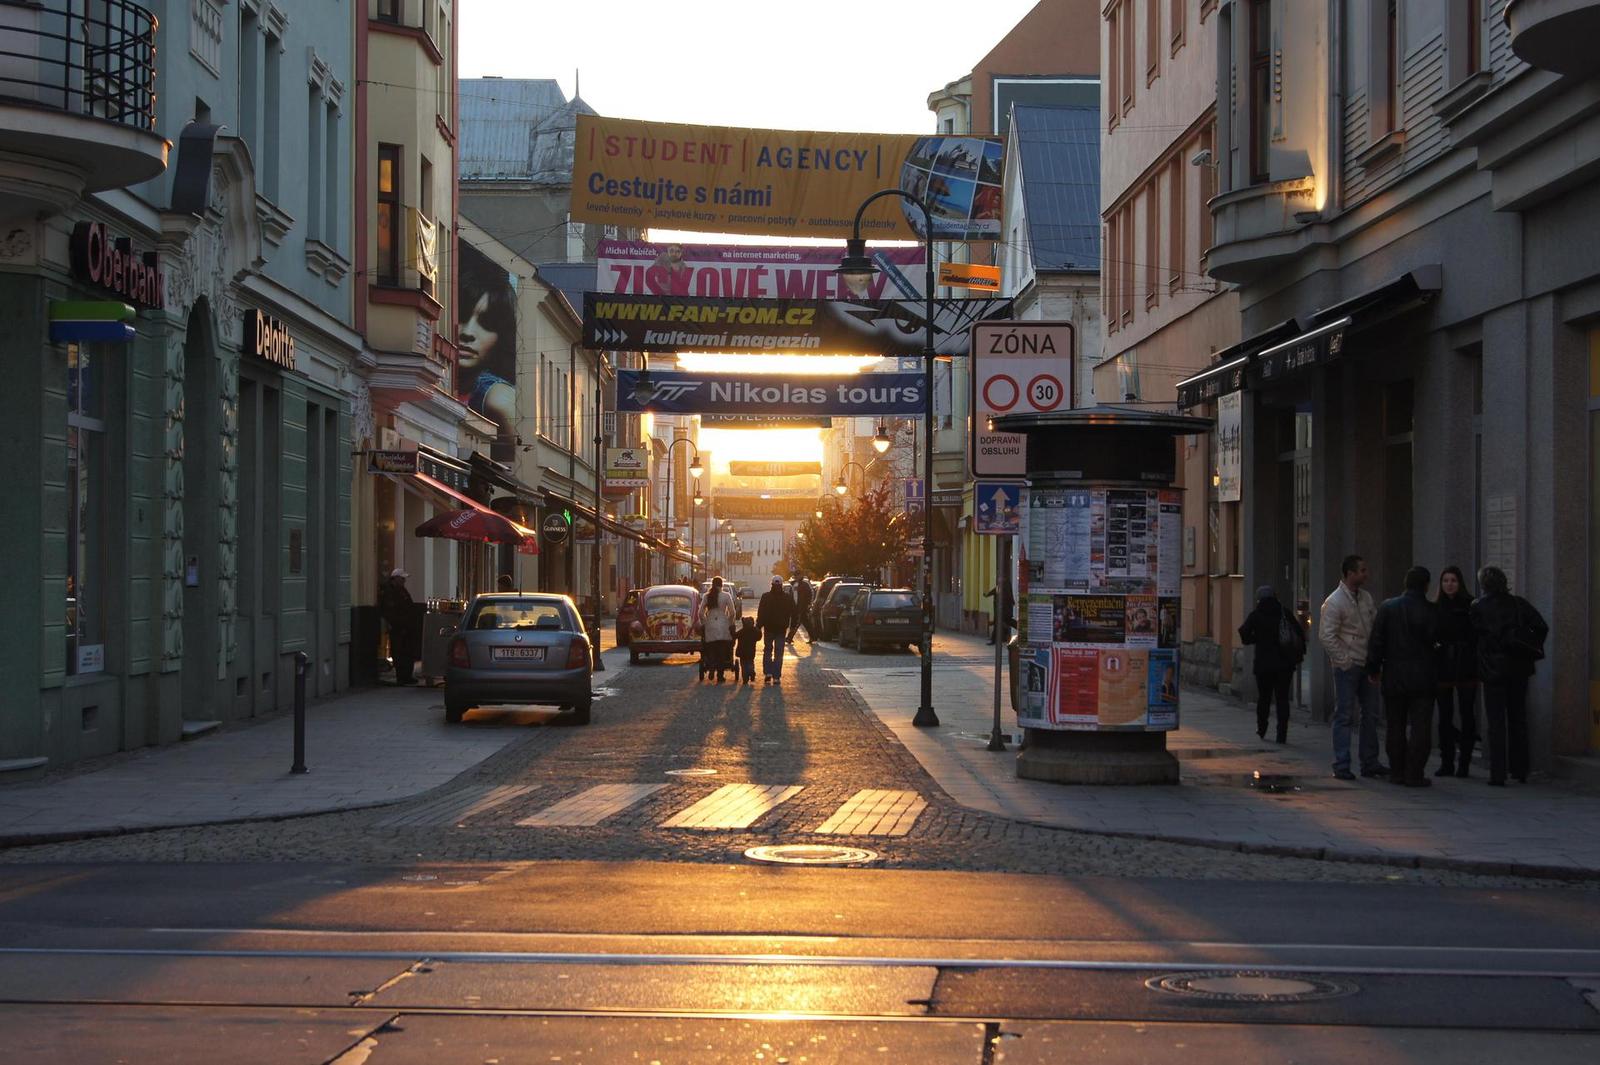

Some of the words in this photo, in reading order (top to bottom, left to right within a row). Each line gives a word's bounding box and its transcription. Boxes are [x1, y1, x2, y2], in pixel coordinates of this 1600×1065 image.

[605, 135, 732, 164] STUDENT
[756, 146, 868, 171] AGENCY
[588, 172, 688, 205] Cestujte
[695, 187, 707, 203] s
[714, 182, 772, 206] námi
[728, 214, 764, 224] pracovní
[767, 215, 797, 227] pobyty
[605, 246, 628, 256] Michal
[733, 250, 762, 259] internet
[88, 222, 165, 310] Oberbank
[595, 302, 816, 325] WWW.FAN-TOM.CZ
[644, 330, 728, 345] kulturní
[731, 332, 820, 351] magazín
[990, 330, 1056, 354] ZÓNA
[710, 381, 827, 403] Nikolas
[837, 383, 919, 403] tours
[1036, 385, 1053, 400] 30
[980, 434, 1020, 444] DOPRAVNÍ
[981, 447, 1020, 455] OBSLUHU
